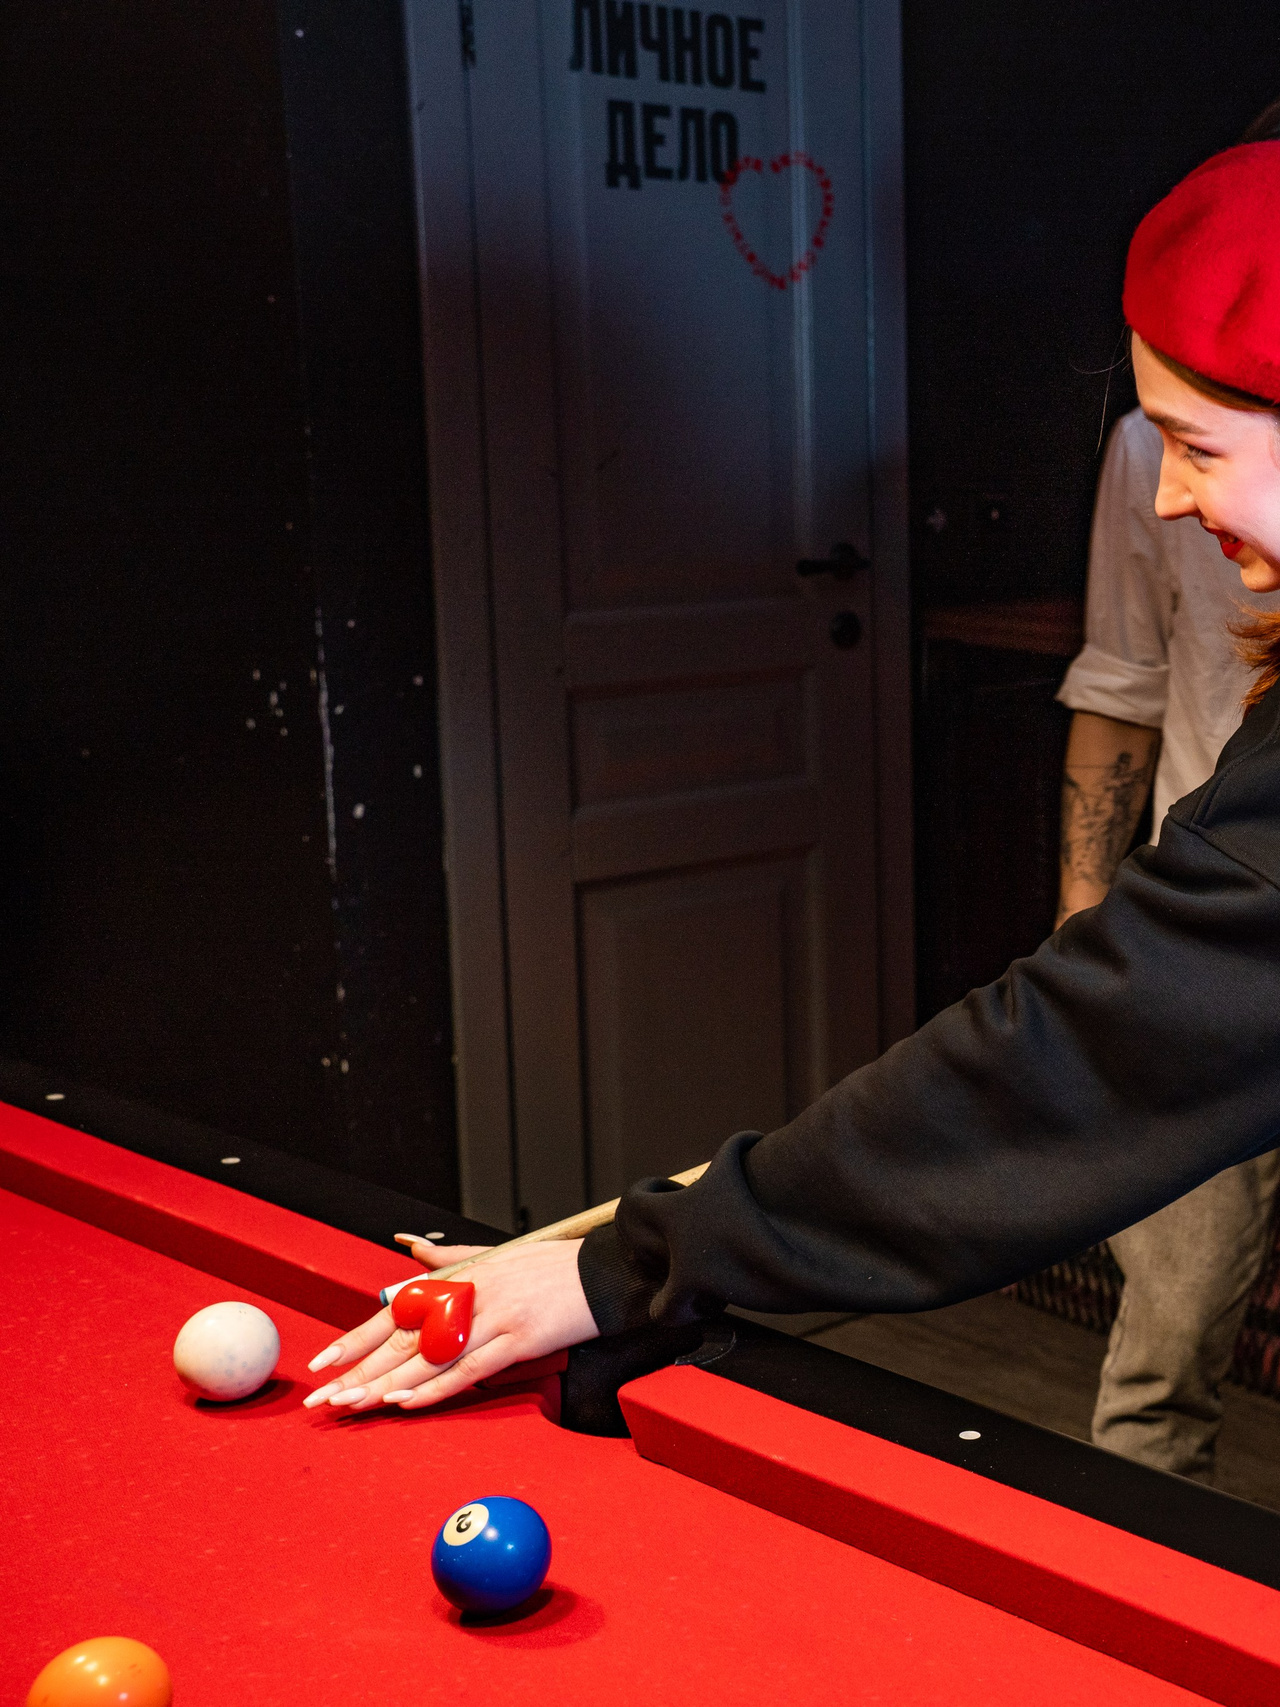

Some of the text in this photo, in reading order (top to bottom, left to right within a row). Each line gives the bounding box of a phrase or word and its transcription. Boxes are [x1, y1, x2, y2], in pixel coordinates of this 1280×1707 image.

[570, 0, 766, 92] ЛИЧНОЕ
[606, 99, 738, 190] ДЕЛО
[456, 1510, 472, 1533] 2
